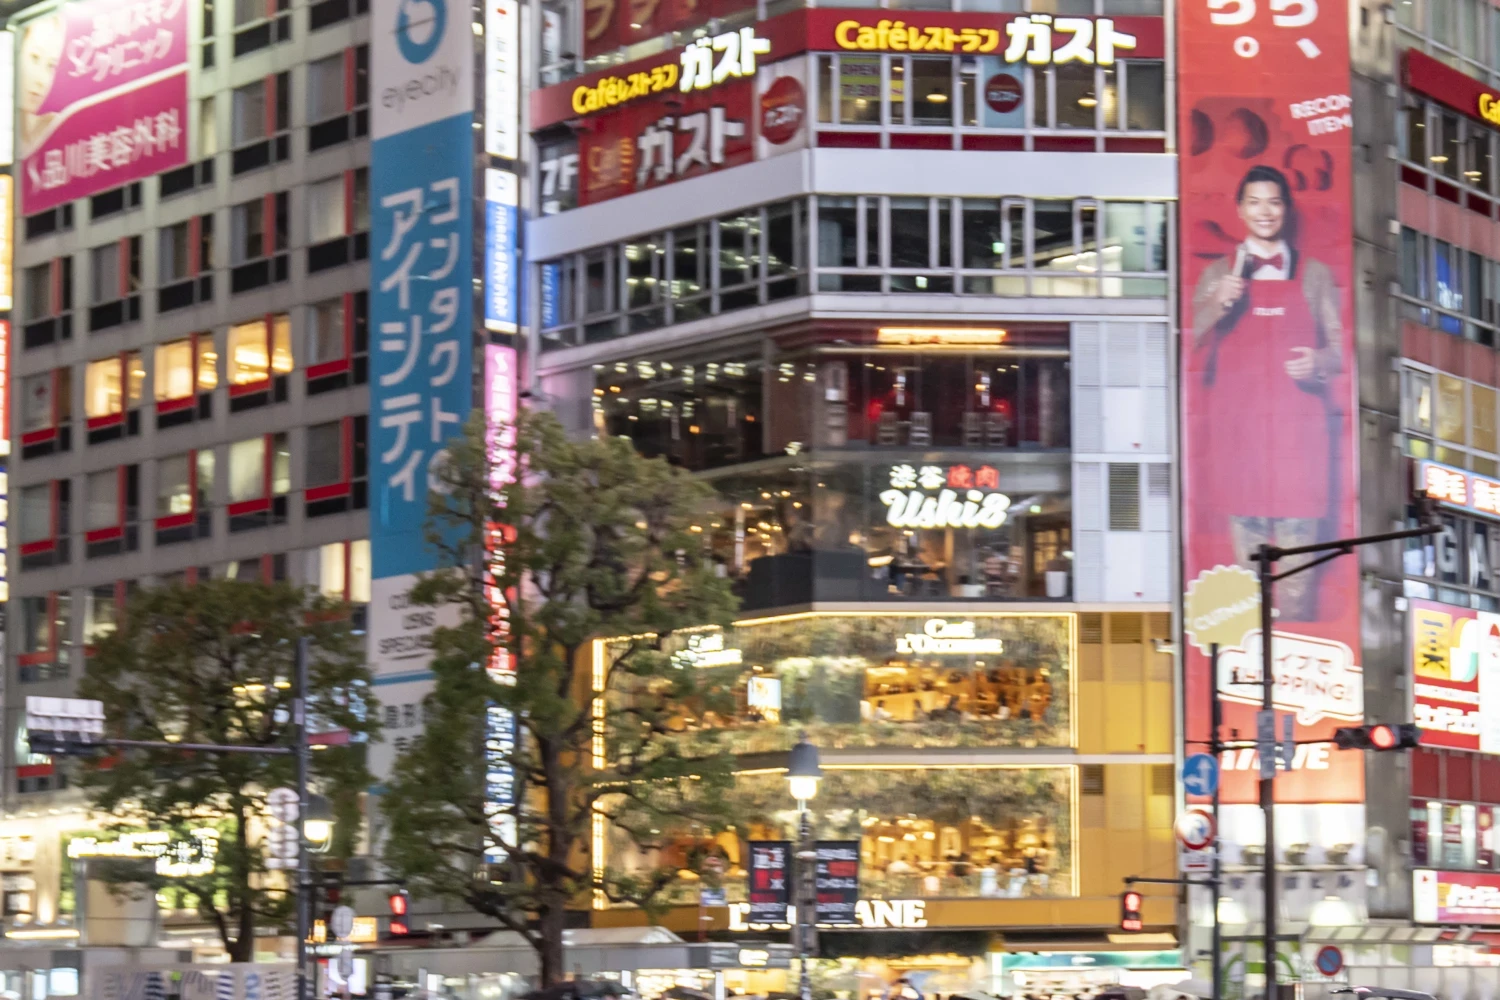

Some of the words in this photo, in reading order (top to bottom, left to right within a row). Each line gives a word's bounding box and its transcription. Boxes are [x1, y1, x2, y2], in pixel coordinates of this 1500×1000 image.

[679, 26, 771, 93] ガスト
[1004, 13, 1137, 65] ガスト
[540, 154, 578, 196] 7F
[636, 106, 744, 190] ガスト
[379, 187, 425, 502] アイシティ
[889, 463, 999, 489] 渋谷焼肉
